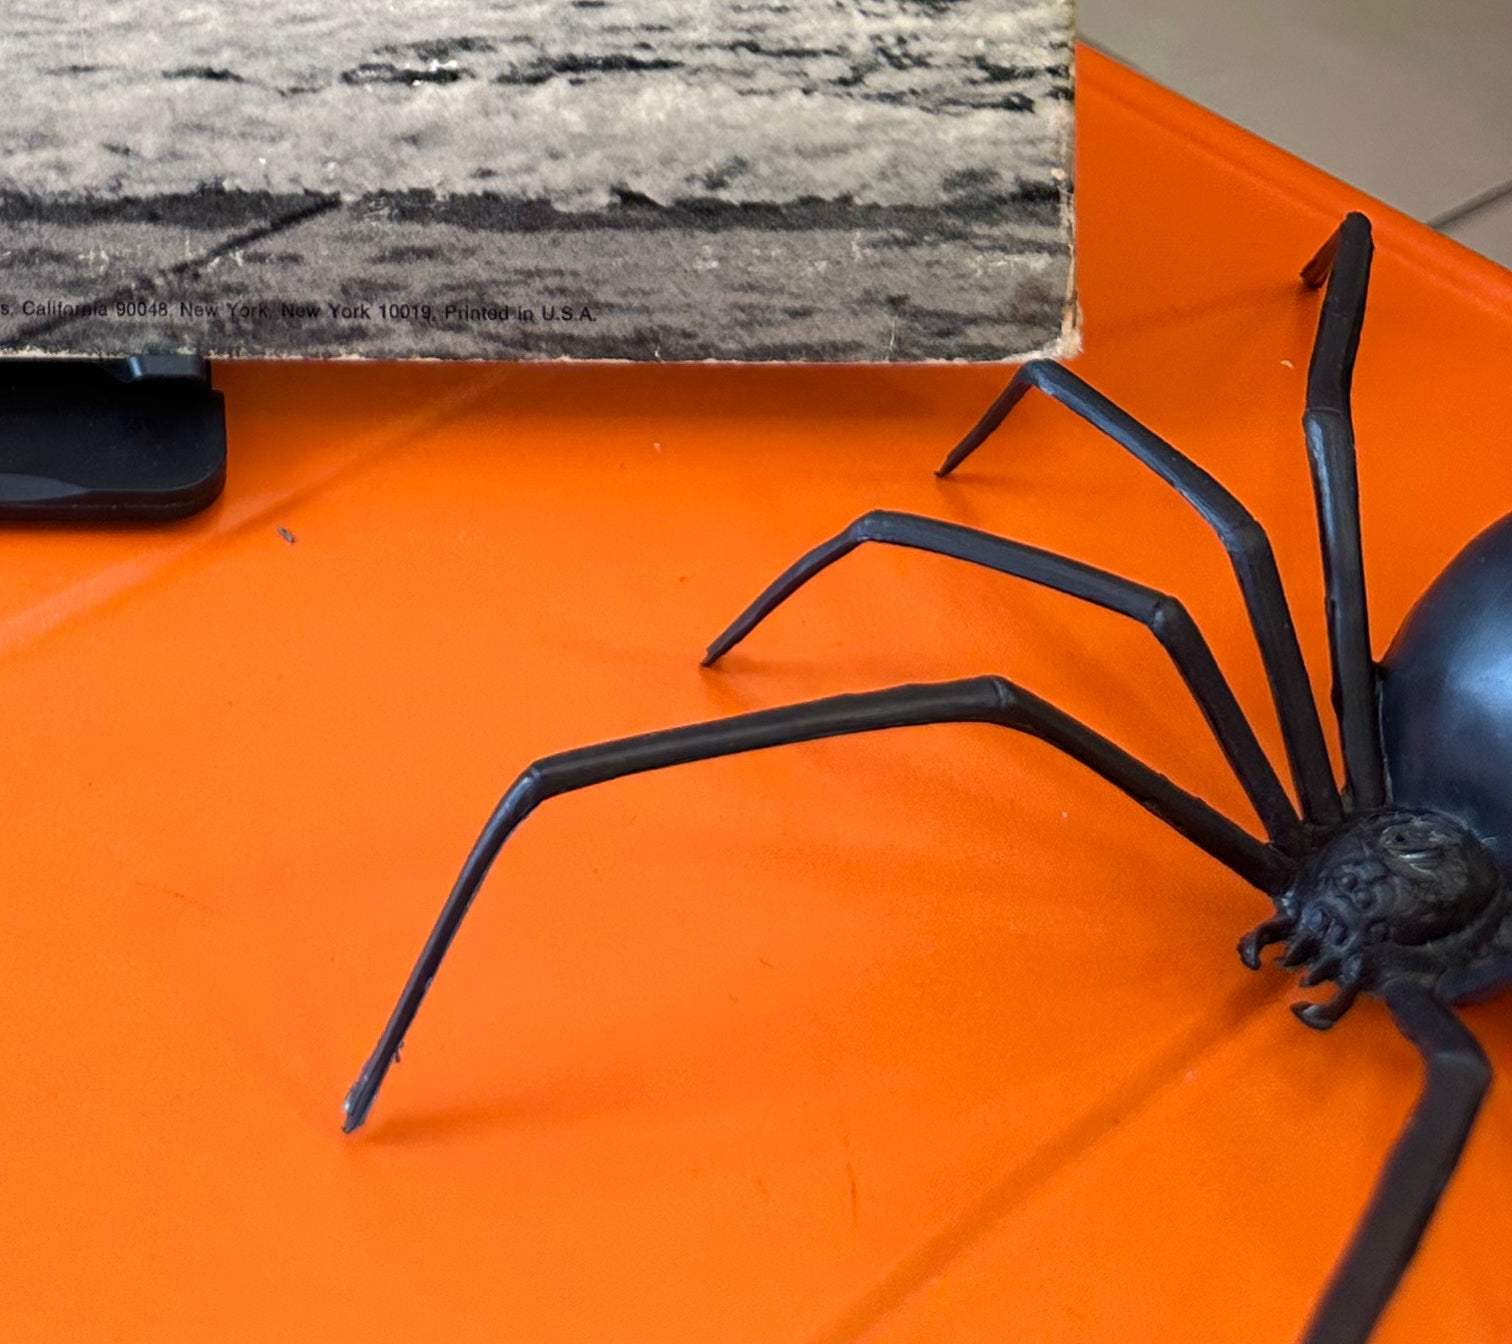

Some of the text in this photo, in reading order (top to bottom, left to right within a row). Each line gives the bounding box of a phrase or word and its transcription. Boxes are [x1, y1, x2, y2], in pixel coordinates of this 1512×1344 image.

[22, 300, 108, 316] California
[180, 302, 219, 317] New
[281, 303, 320, 318] New
[328, 303, 371, 319] York
[445, 304, 509, 321] Printed
[518, 305, 534, 321] in
[542, 305, 597, 321] U.S.A.
